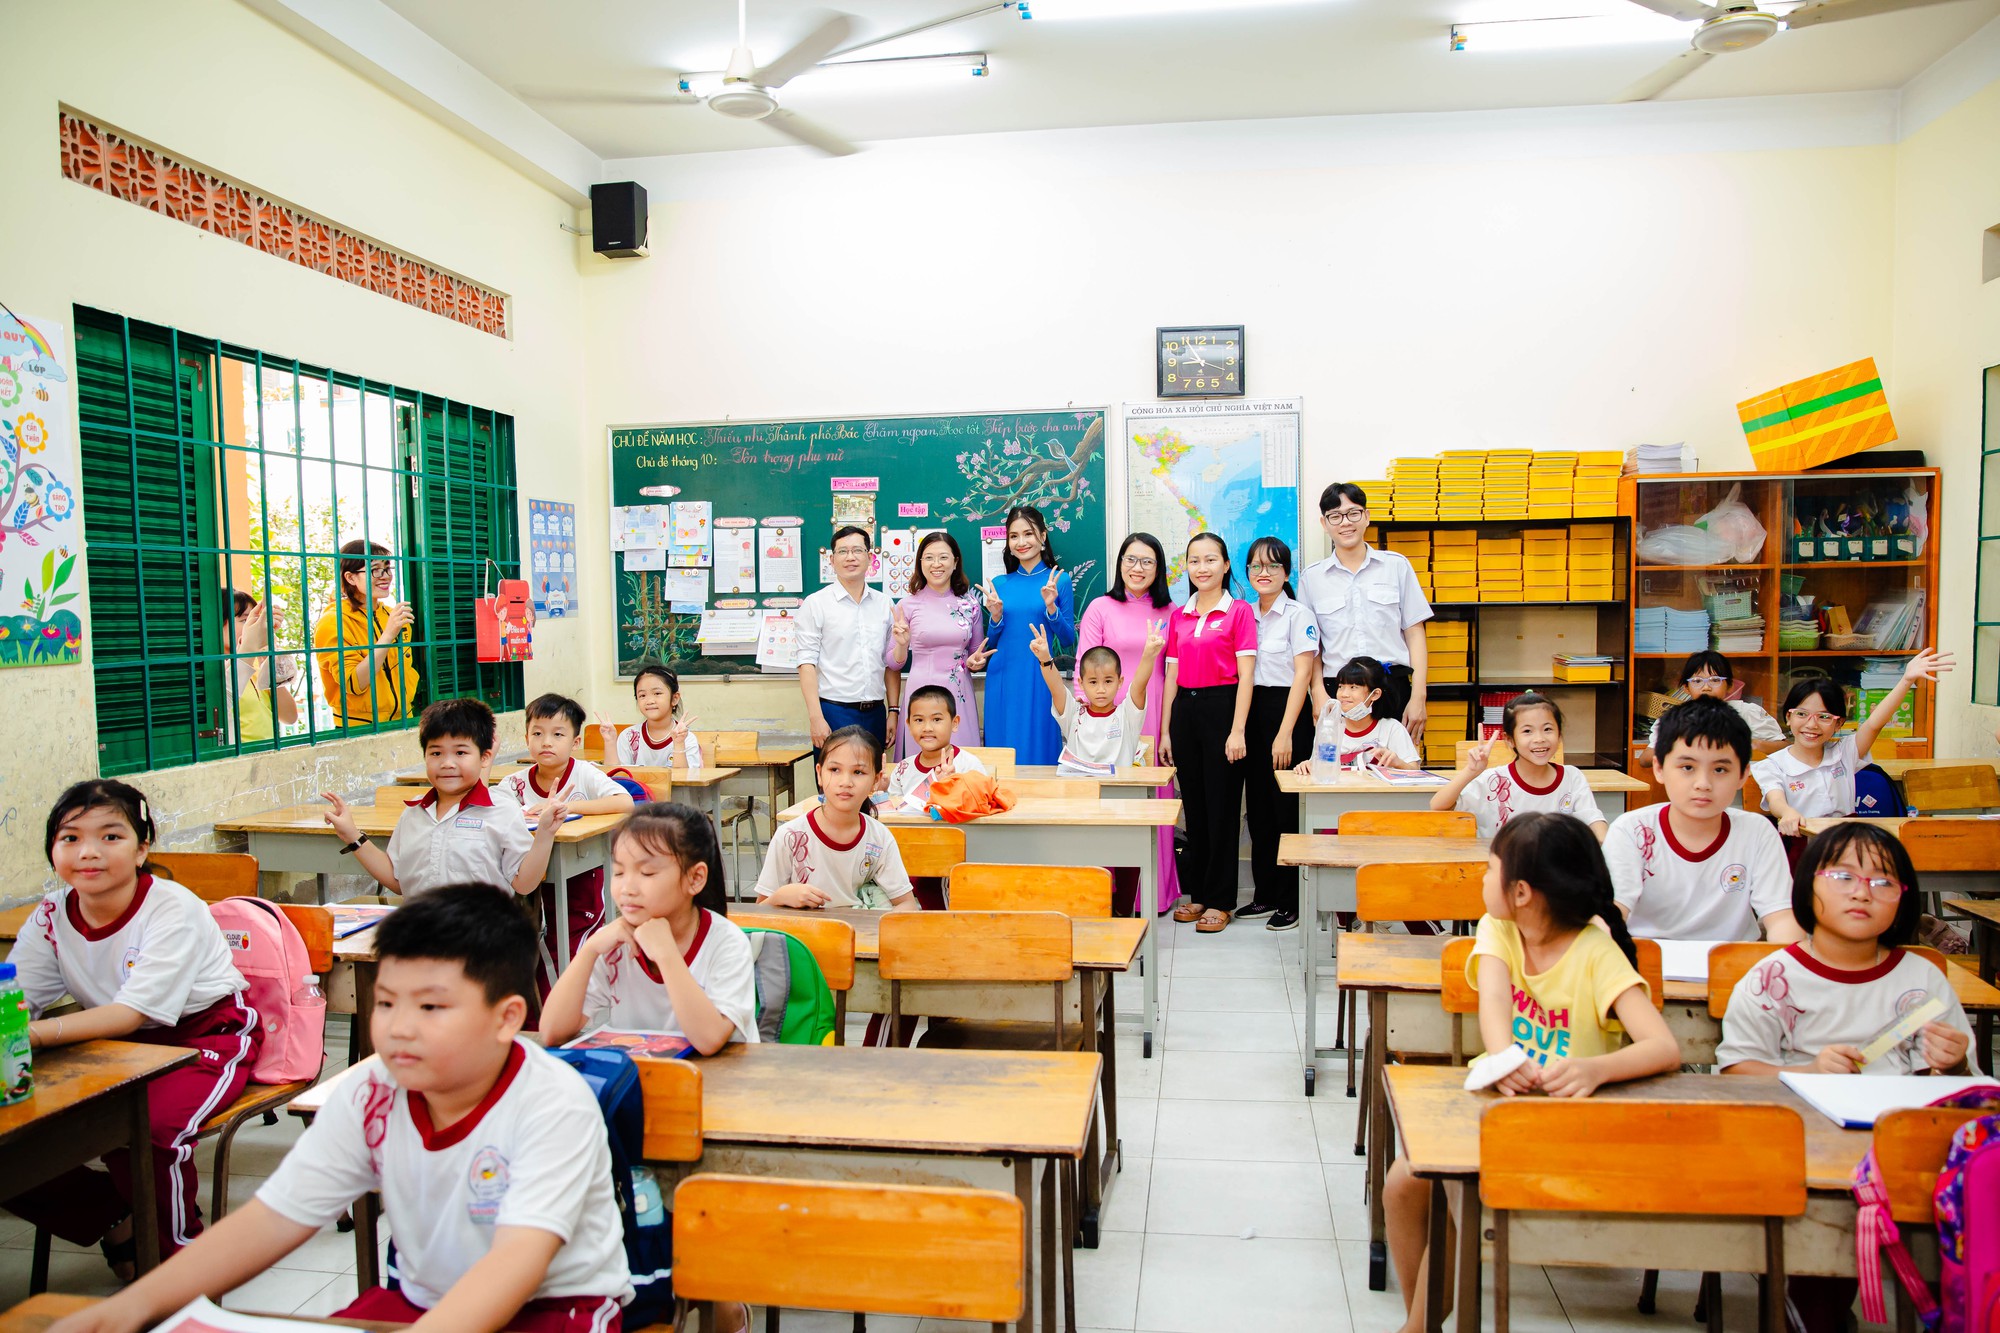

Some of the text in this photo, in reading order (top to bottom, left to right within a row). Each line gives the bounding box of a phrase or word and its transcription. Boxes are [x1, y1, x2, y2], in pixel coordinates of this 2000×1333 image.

[4, 331, 26, 343] QUY
[1195, 336, 1207, 344] 12
[1211, 336, 1216, 344] 1
[1166, 342, 1178, 350] 10
[1226, 341, 1234, 350] 2
[1168, 358, 1176, 366] 9
[1226, 356, 1234, 366] 3
[1168, 374, 1176, 382] 8
[1226, 372, 1234, 382] 4
[1183, 378, 1220, 388] 7 6 5
[1132, 407, 1156, 415] CỘNG
[1190, 405, 1204, 414] HỘI
[1206, 404, 1222, 412] CHỦ
[1224, 404, 1251, 412] NGHĨA
[1252, 403, 1273, 412] VIỆT
[613, 432, 635, 448] CHỦ
[637, 431, 650, 446] ĐỀ
[652, 430, 674, 446] NĂM
[745, 427, 764, 443] nhi
[765, 424, 806, 444] Thành
[810, 424, 831, 446] phố
[831, 424, 860, 440] Bác
[938, 417, 964, 438] Học
[982, 416, 1011, 438] Tiếp
[1042, 417, 1060, 432] cha
[636, 454, 656, 468] Chủ
[658, 454, 669, 468] đề
[671, 454, 698, 471] tháng
[726, 446, 757, 464] Tôn
[764, 450, 794, 474] trọng
[798, 445, 821, 470] phụ
[826, 448, 844, 462] nữ
[900, 505, 926, 514] Học tập
[1512, 984, 1568, 1028] WISH
[1512, 1016, 1570, 1058] OVE
